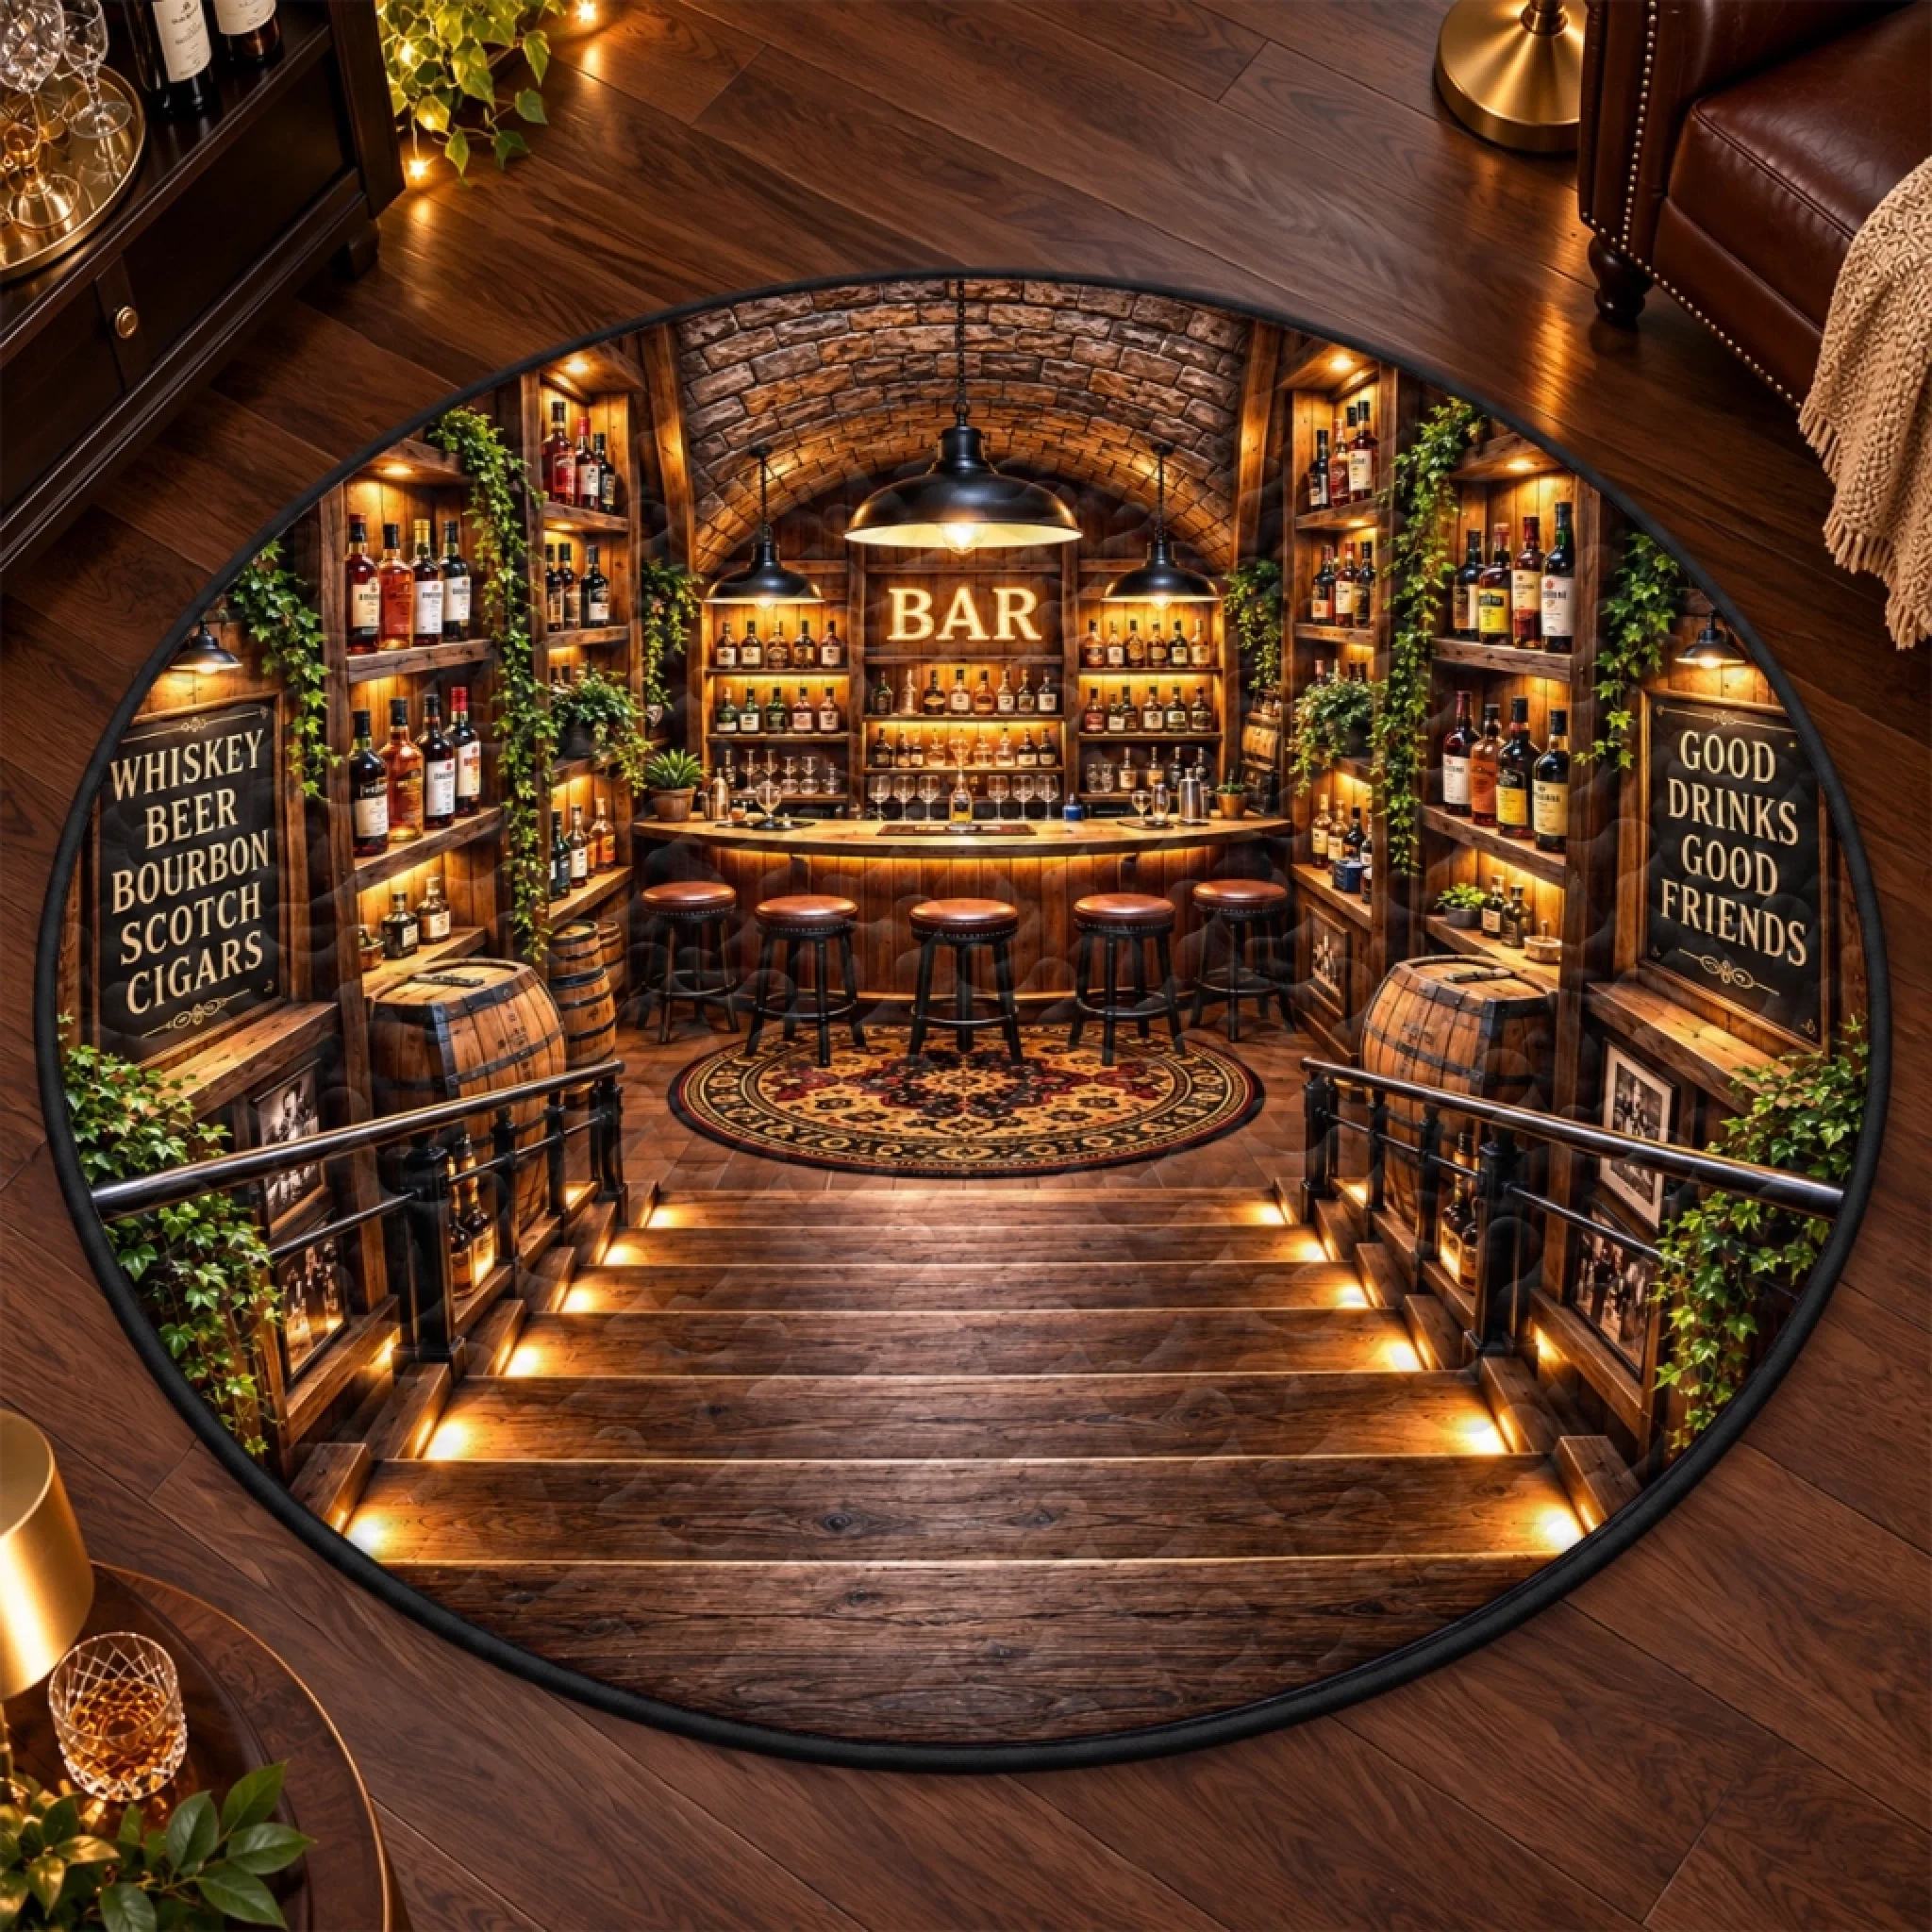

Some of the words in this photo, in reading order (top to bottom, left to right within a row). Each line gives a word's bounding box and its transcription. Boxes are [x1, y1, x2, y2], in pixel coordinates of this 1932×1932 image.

[887, 586, 1042, 641] BAR
[110, 729, 264, 801] WHISKEY
[1680, 730, 1775, 783] GOOD
[145, 788, 238, 849] BEER
[1668, 777, 1798, 846] DRINKS
[111, 829, 269, 914] BOURBON
[1681, 834, 1778, 896] GOOD
[121, 881, 261, 966] SCOTCH
[1660, 878, 1807, 967] FRIENDS
[126, 929, 263, 1014] CIGARS
